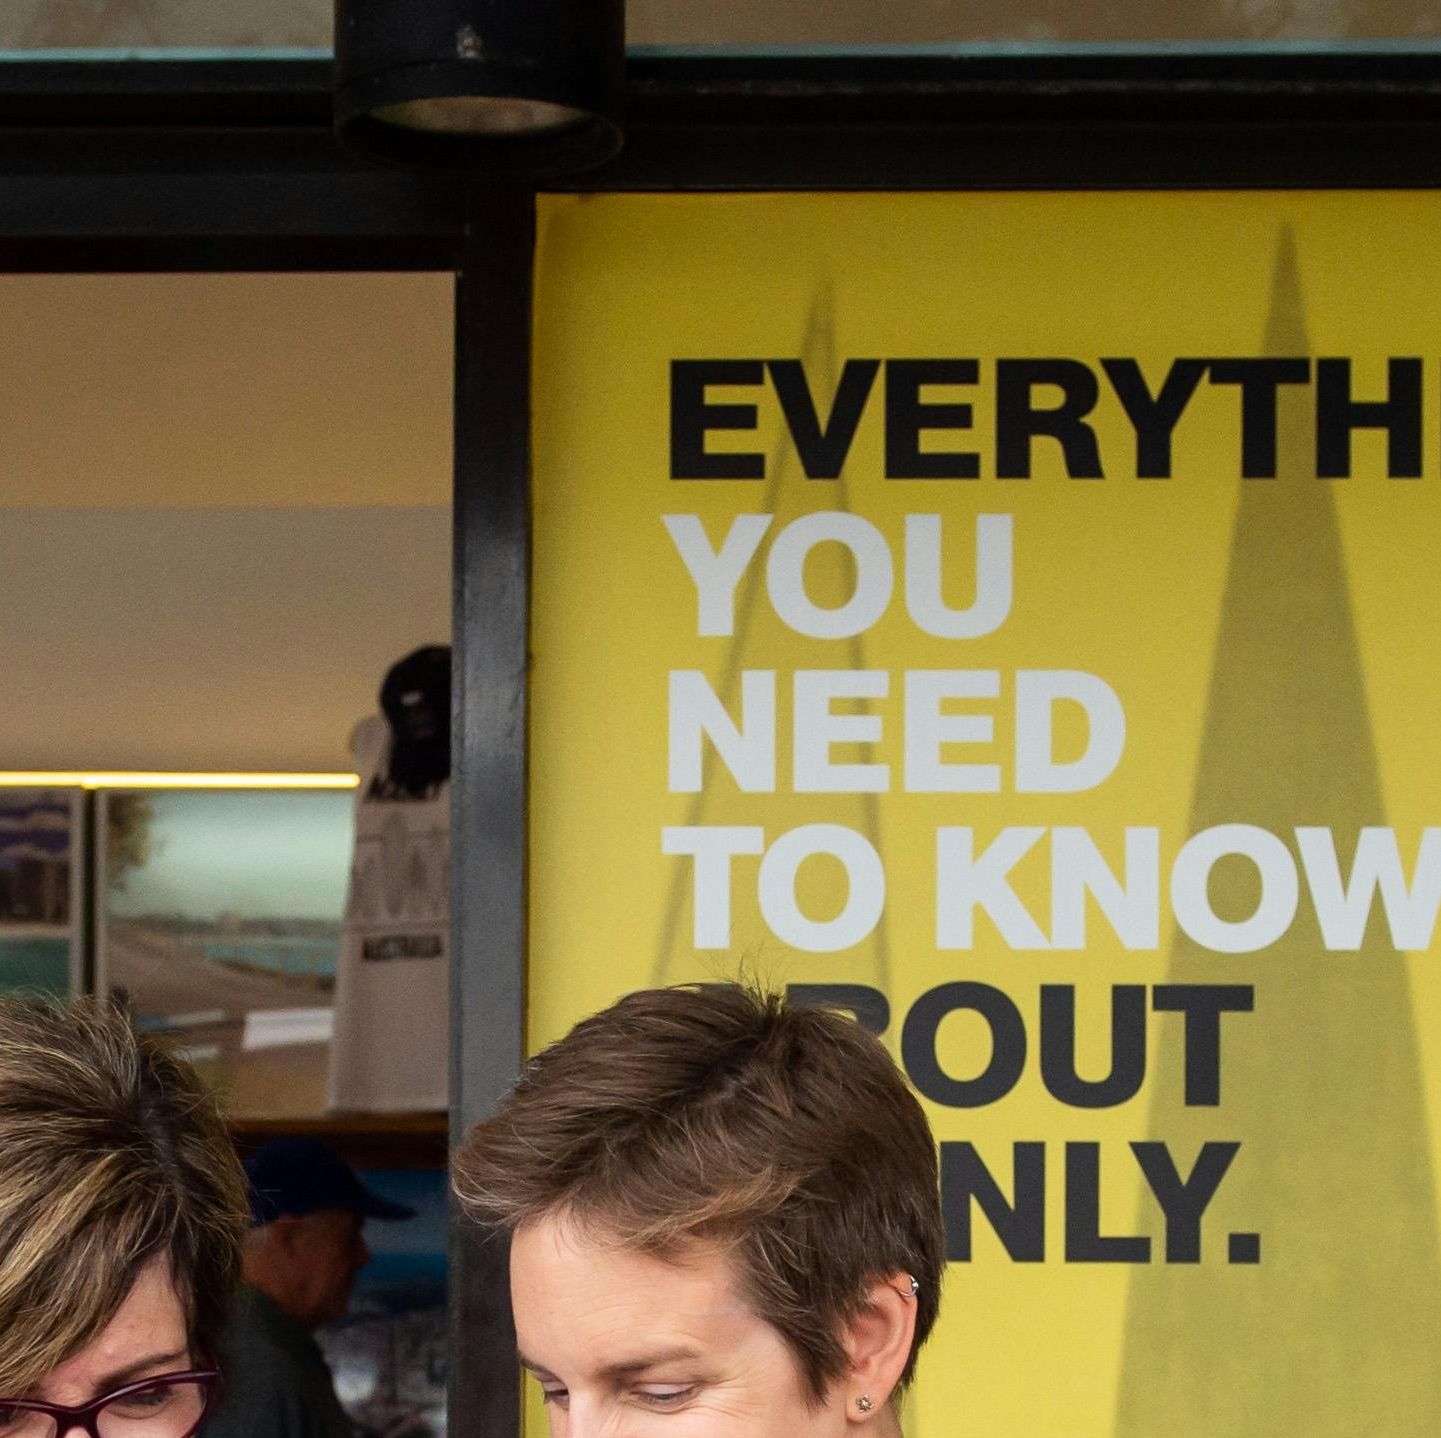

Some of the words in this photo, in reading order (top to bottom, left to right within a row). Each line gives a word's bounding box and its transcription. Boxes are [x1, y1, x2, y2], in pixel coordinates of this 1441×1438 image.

[664, 511, 1015, 641] YOU
[667, 669, 1128, 795] NEED
[661, 823, 889, 953] TO
[785, 981, 1255, 1109] OUT
[937, 1140, 1261, 1264] NLY.
